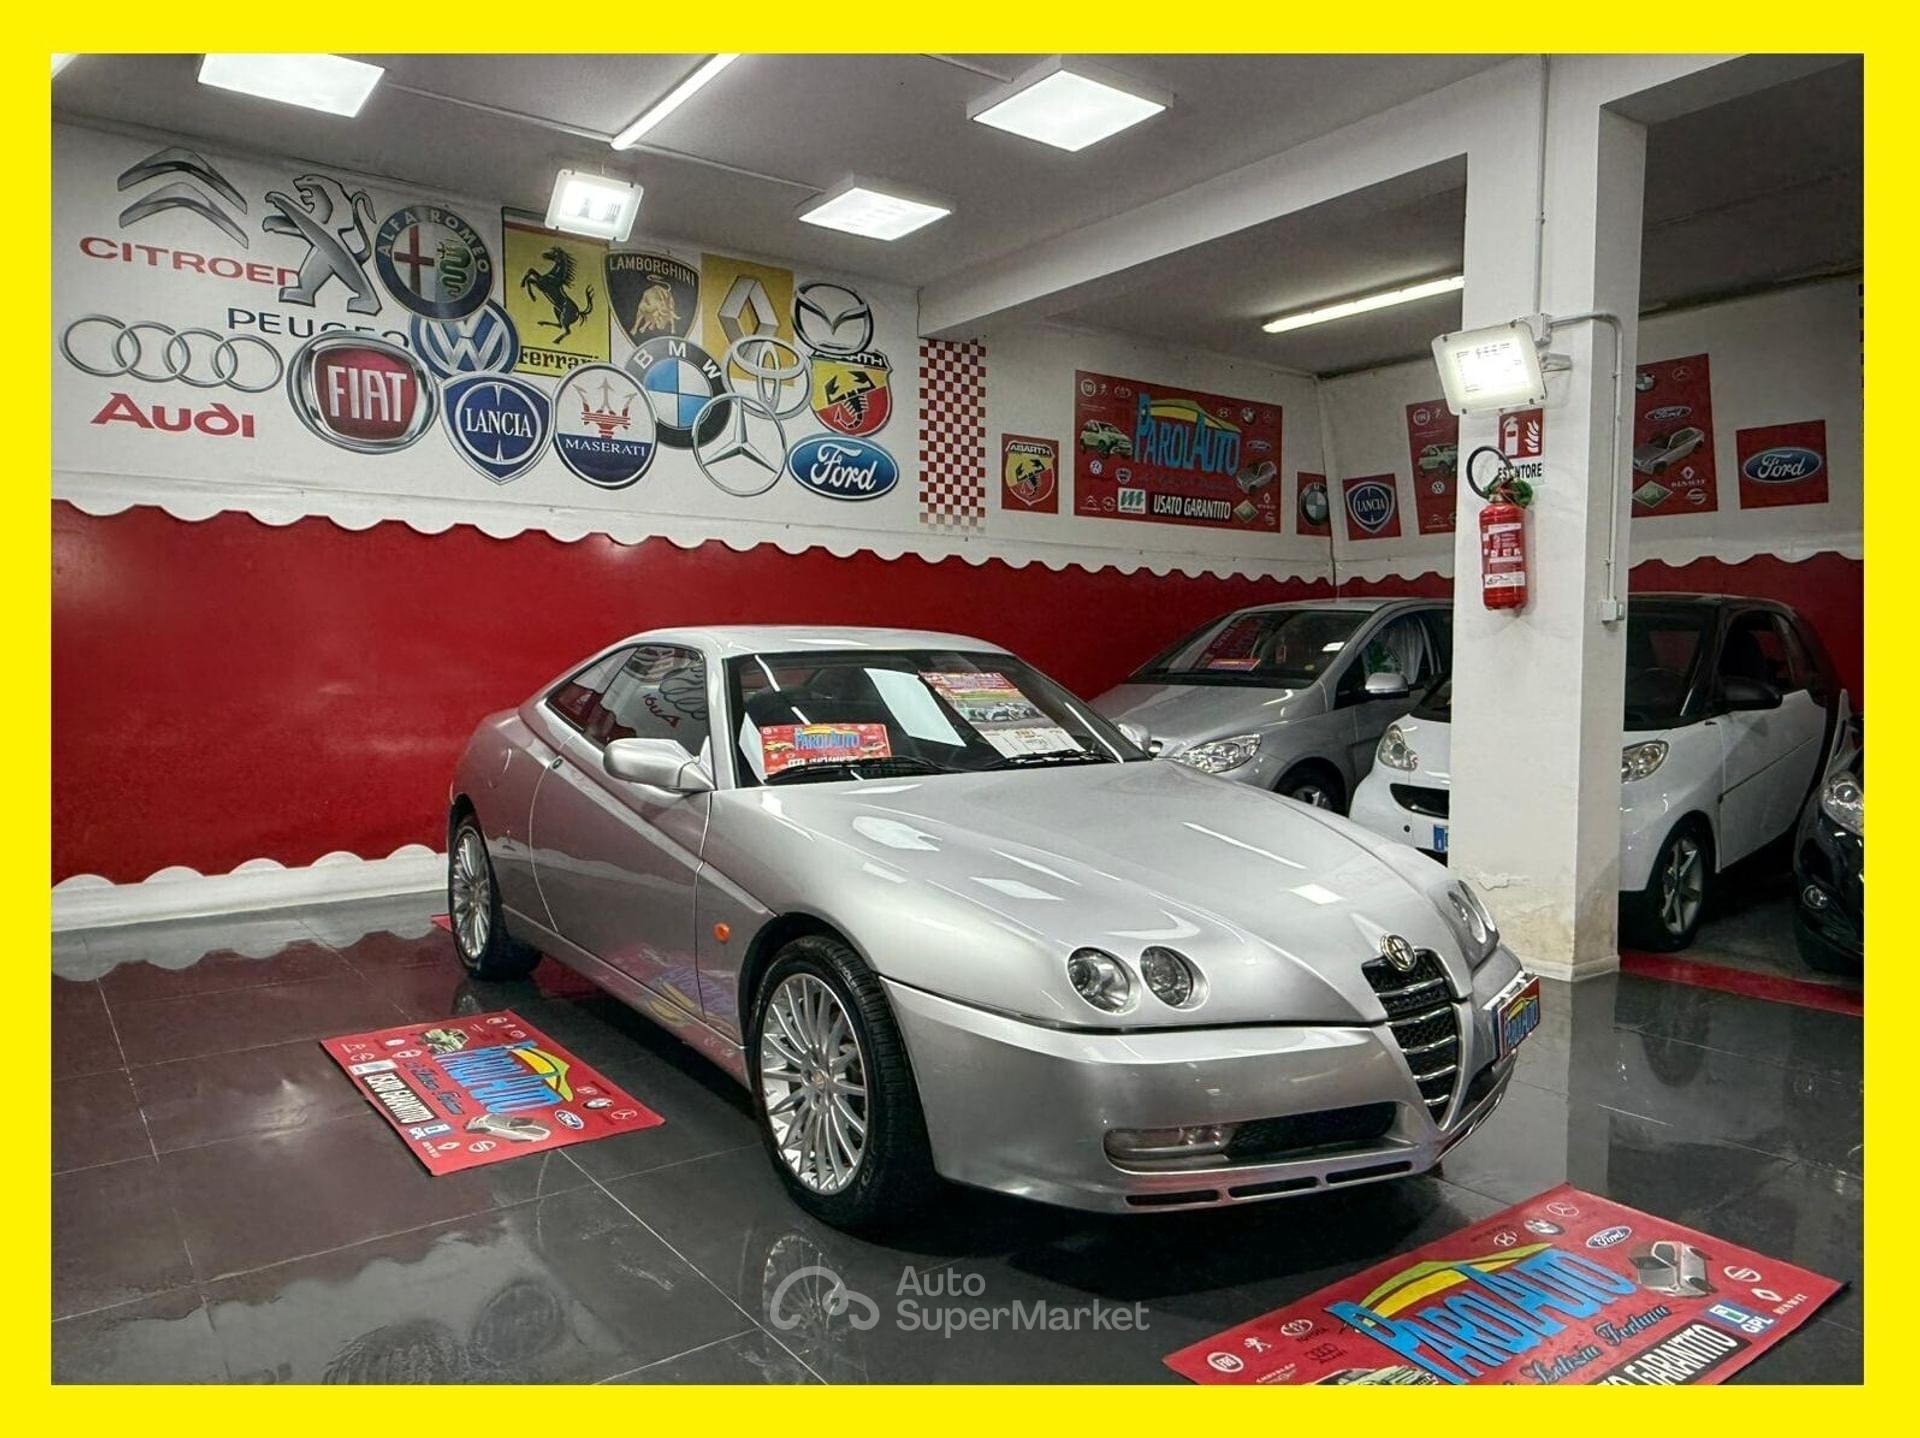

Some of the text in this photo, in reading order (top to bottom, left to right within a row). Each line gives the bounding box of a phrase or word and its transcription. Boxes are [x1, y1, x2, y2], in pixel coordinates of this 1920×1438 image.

[376, 209, 490, 273] ALFA ROMEO
[608, 253, 696, 288] LAMBORGHINI
[327, 365, 408, 423] FIAT
[90, 391, 256, 439] Audi
[464, 406, 534, 438] LANCIA
[564, 438, 647, 459] MASERATI
[1009, 443, 1051, 456] ABARTH
[810, 443, 878, 491] Ford
[1757, 452, 1807, 479] Ford
[1152, 493, 1232, 520] USATO GARANTITO
[1740, 1314, 1774, 1334] GPL
[1624, 1323, 1738, 1384] GARANTITO
